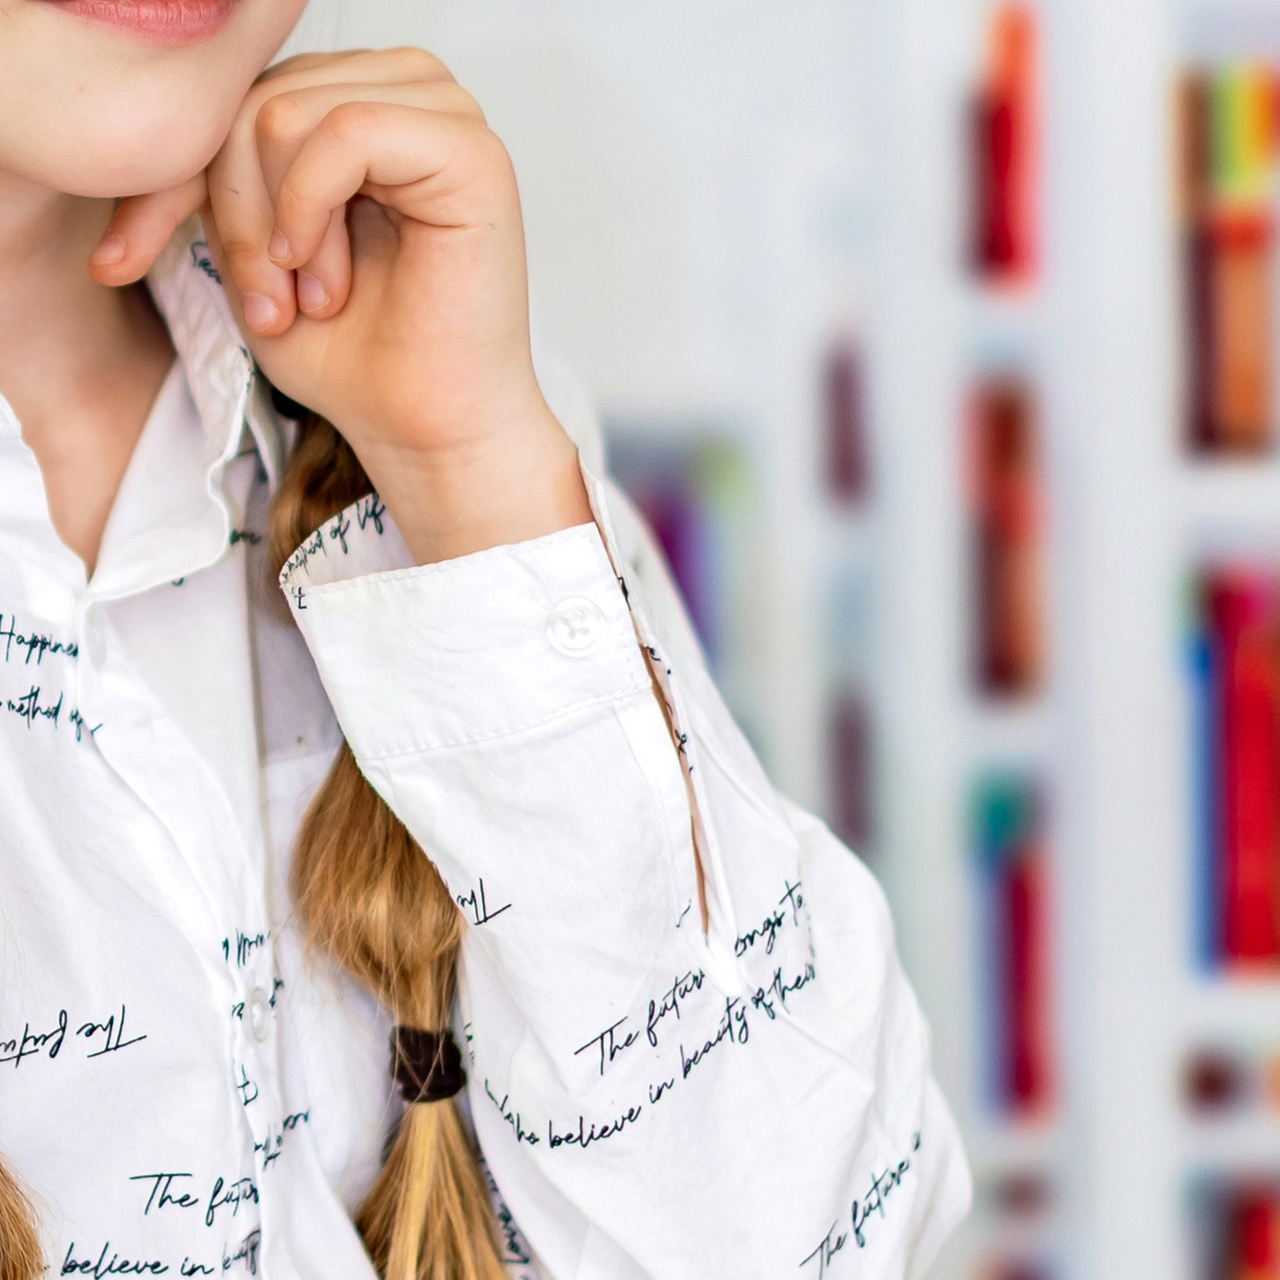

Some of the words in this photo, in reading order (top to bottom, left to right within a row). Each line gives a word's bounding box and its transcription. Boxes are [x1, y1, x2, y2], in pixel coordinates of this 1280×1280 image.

[75, 1003, 148, 1059] The
[573, 1016, 640, 1076] The
[548, 1105, 642, 1150] believe
[649, 1078, 675, 1105] in
[128, 1172, 199, 1216] The
[180, 1256, 215, 1278] in
